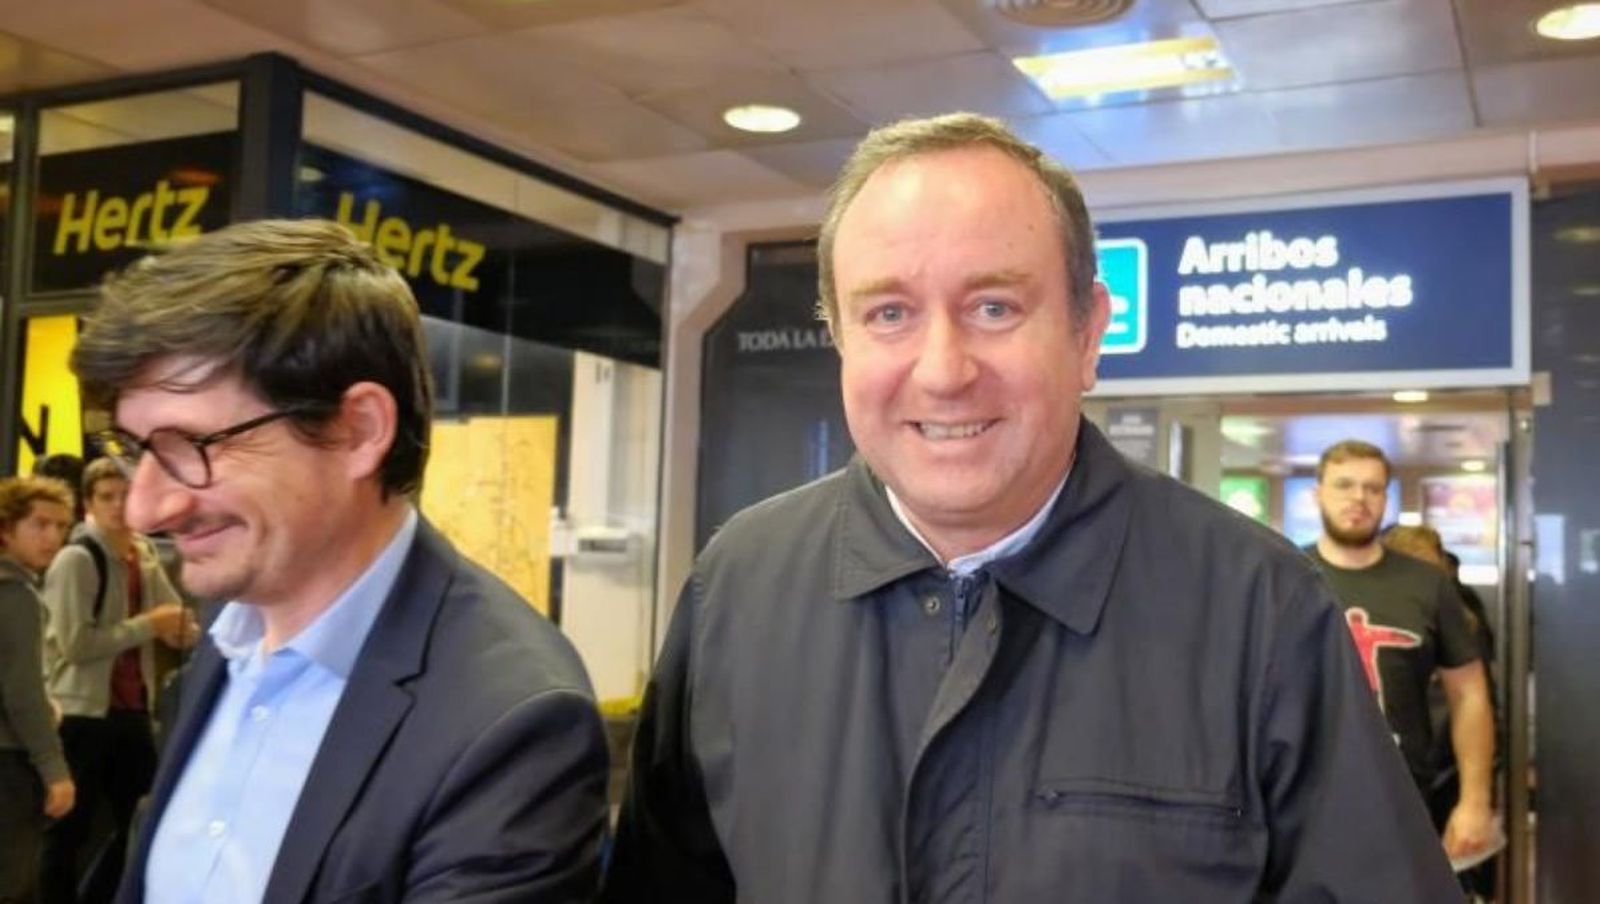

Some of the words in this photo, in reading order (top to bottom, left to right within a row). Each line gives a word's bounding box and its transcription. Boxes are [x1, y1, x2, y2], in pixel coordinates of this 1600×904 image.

[53, 180, 209, 255] Hertz
[337, 192, 485, 292] Hertz
[1178, 230, 1338, 274] Arribos
[1179, 267, 1413, 316] nacionales
[738, 331, 790, 351] TODA
[1176, 320, 1291, 348] Domestic
[1294, 314, 1387, 343] arrivals
